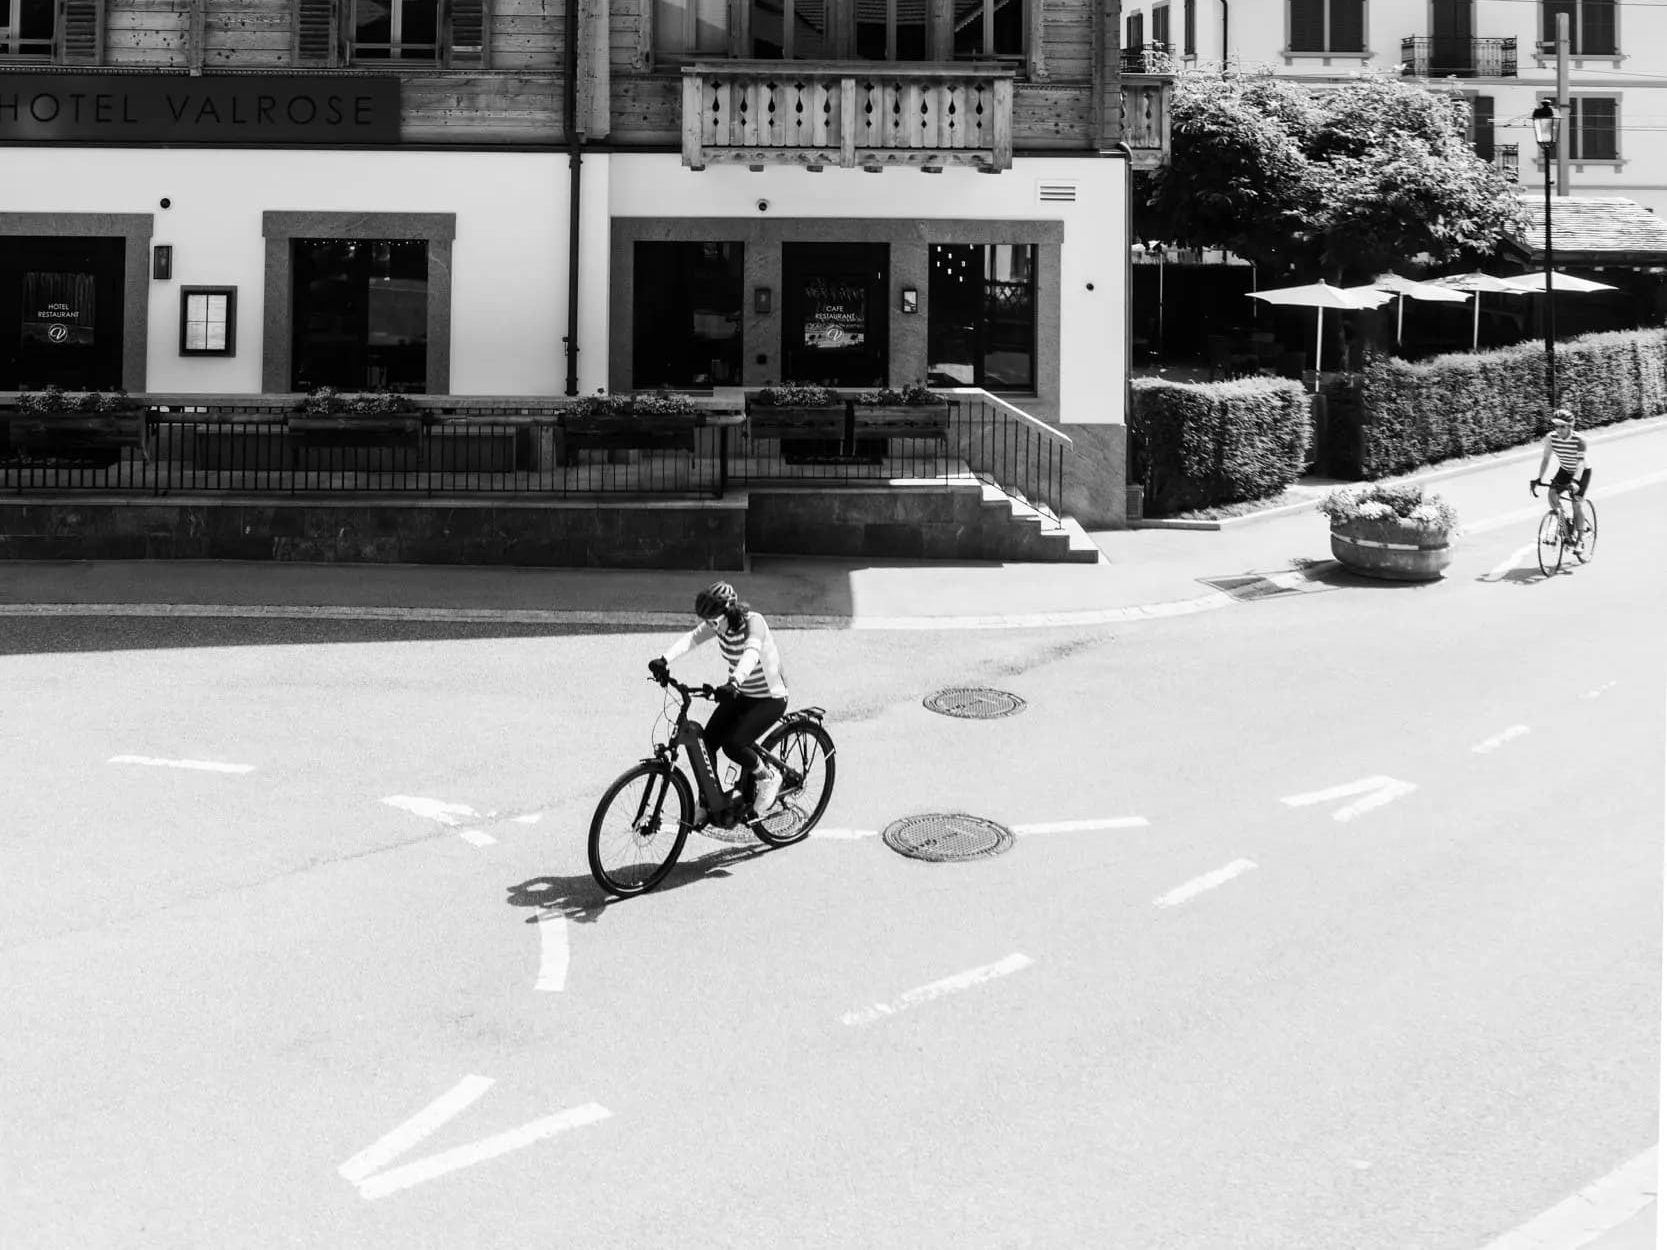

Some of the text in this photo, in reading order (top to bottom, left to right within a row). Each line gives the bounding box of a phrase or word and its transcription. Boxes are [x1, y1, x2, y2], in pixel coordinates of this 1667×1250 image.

[0, 93, 374, 125] HOTEL VALROSE
[697, 736, 716, 779] SCOTT
